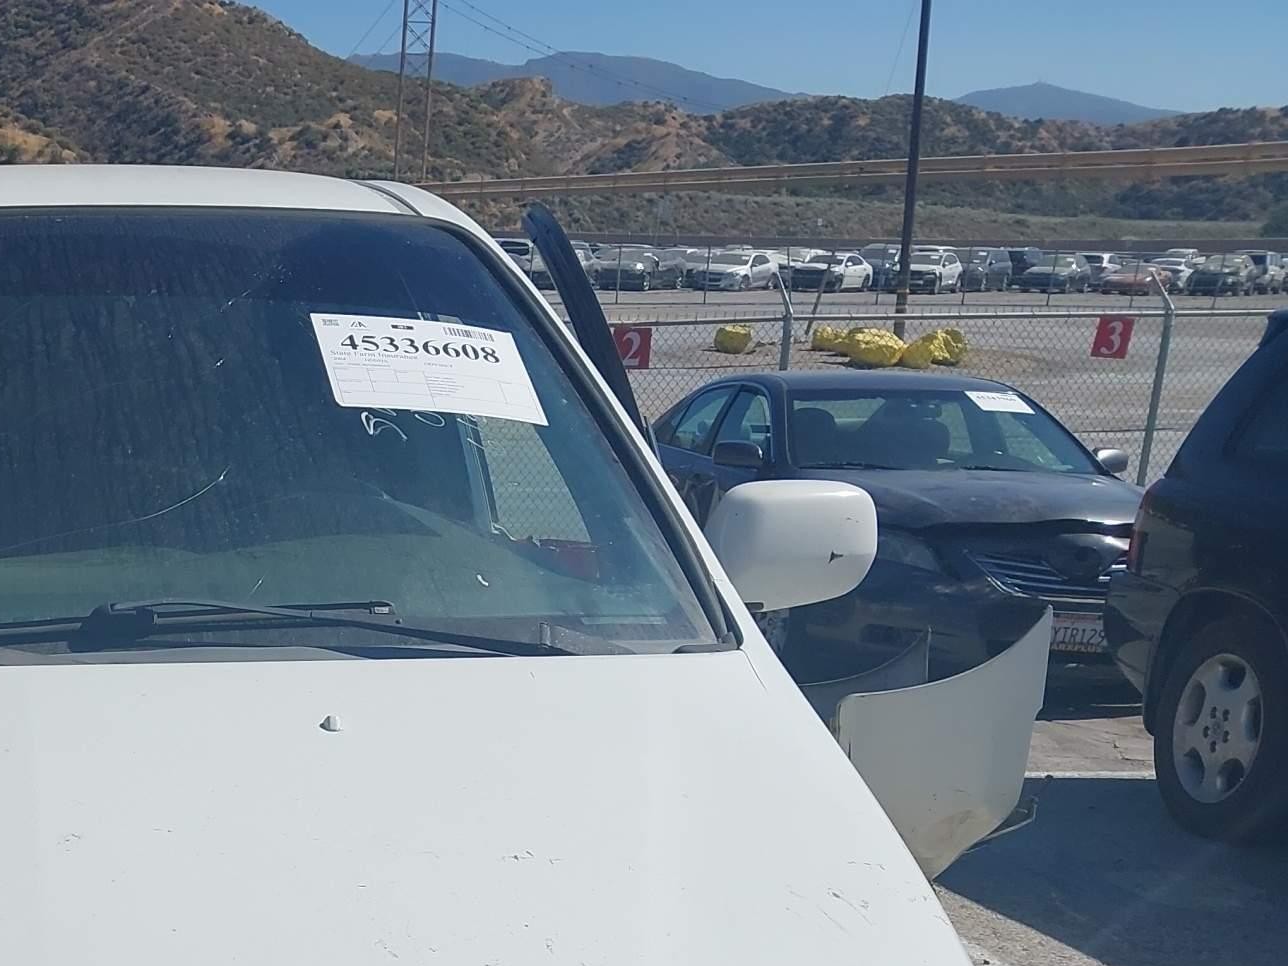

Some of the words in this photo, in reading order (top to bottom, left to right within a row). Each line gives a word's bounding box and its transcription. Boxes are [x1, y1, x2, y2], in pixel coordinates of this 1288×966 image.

[340, 334, 500, 363] 45336608
[623, 331, 641, 366] 2
[1099, 320, 1124, 355] 3
[1052, 626, 1105, 646] YTR129
